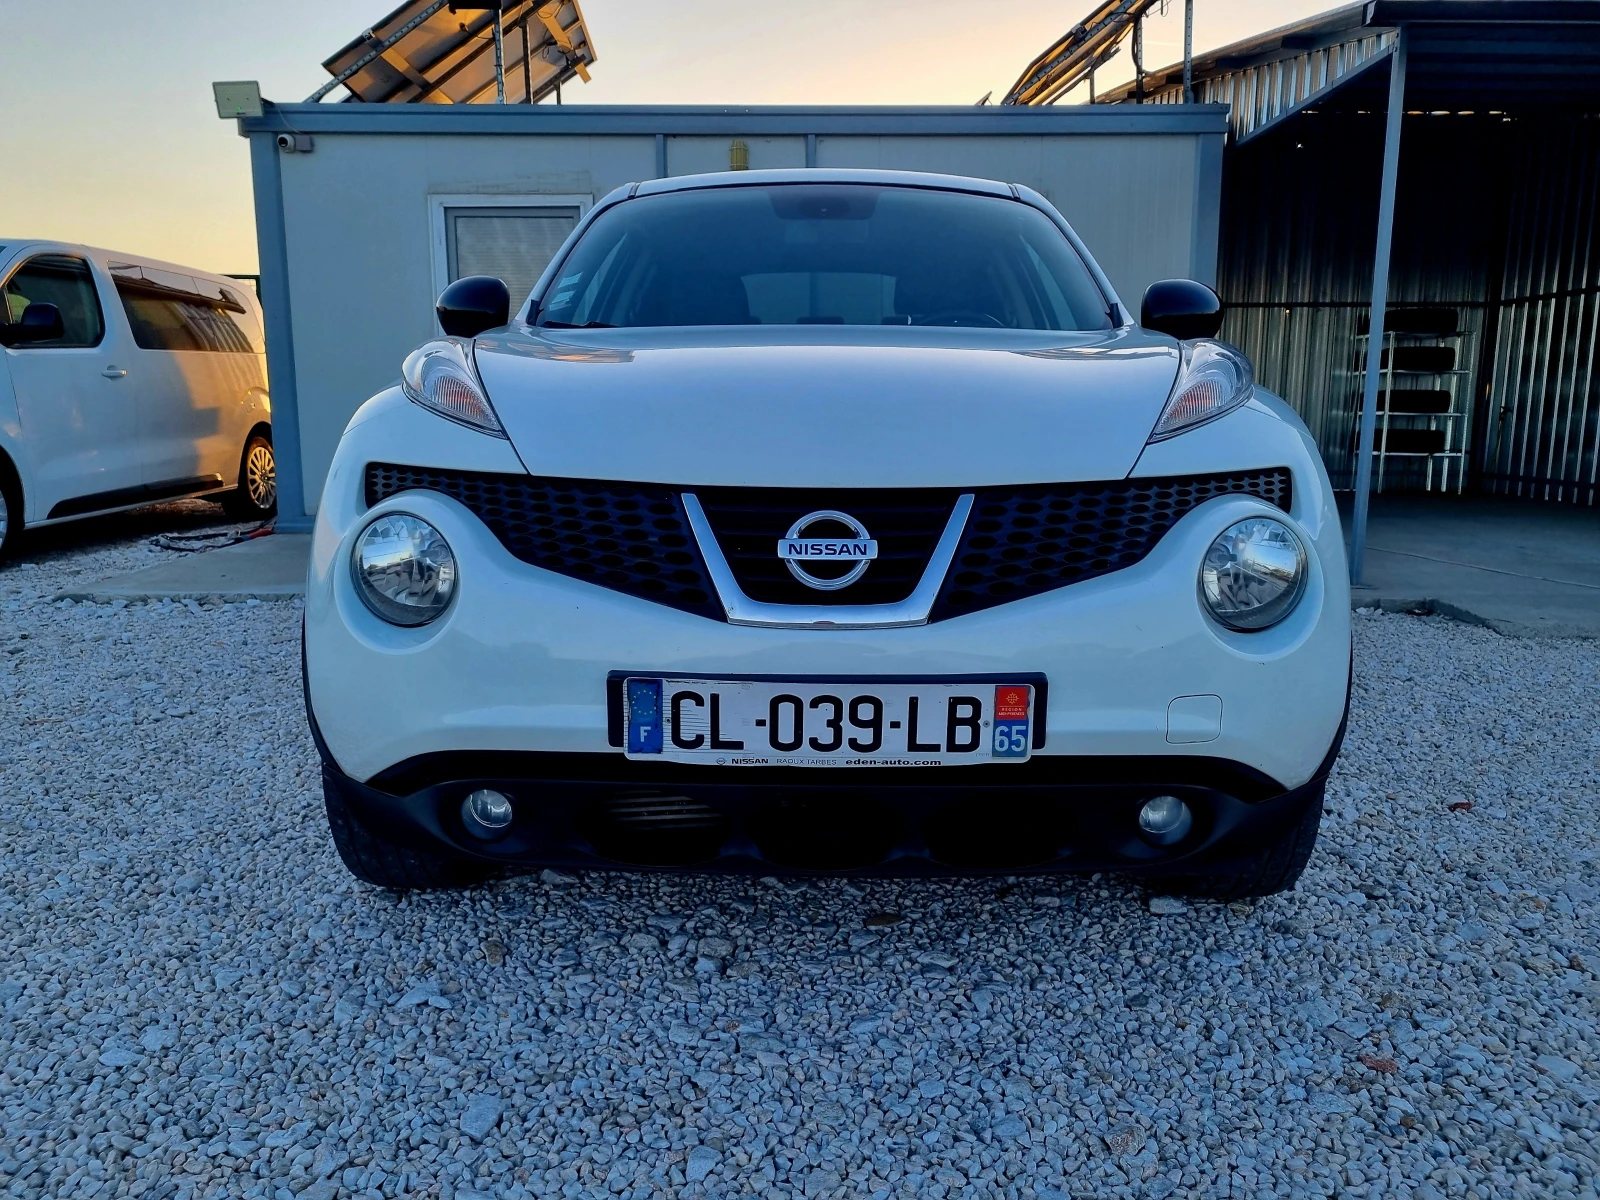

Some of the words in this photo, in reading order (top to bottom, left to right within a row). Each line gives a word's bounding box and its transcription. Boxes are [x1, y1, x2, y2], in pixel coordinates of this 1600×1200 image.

[788, 543, 867, 556] NISSAN
[671, 690, 982, 753] CL-039-LB
[640, 727, 651, 742] F
[994, 726, 1027, 753] 65
[845, 758, 942, 766] eden-auto.com
